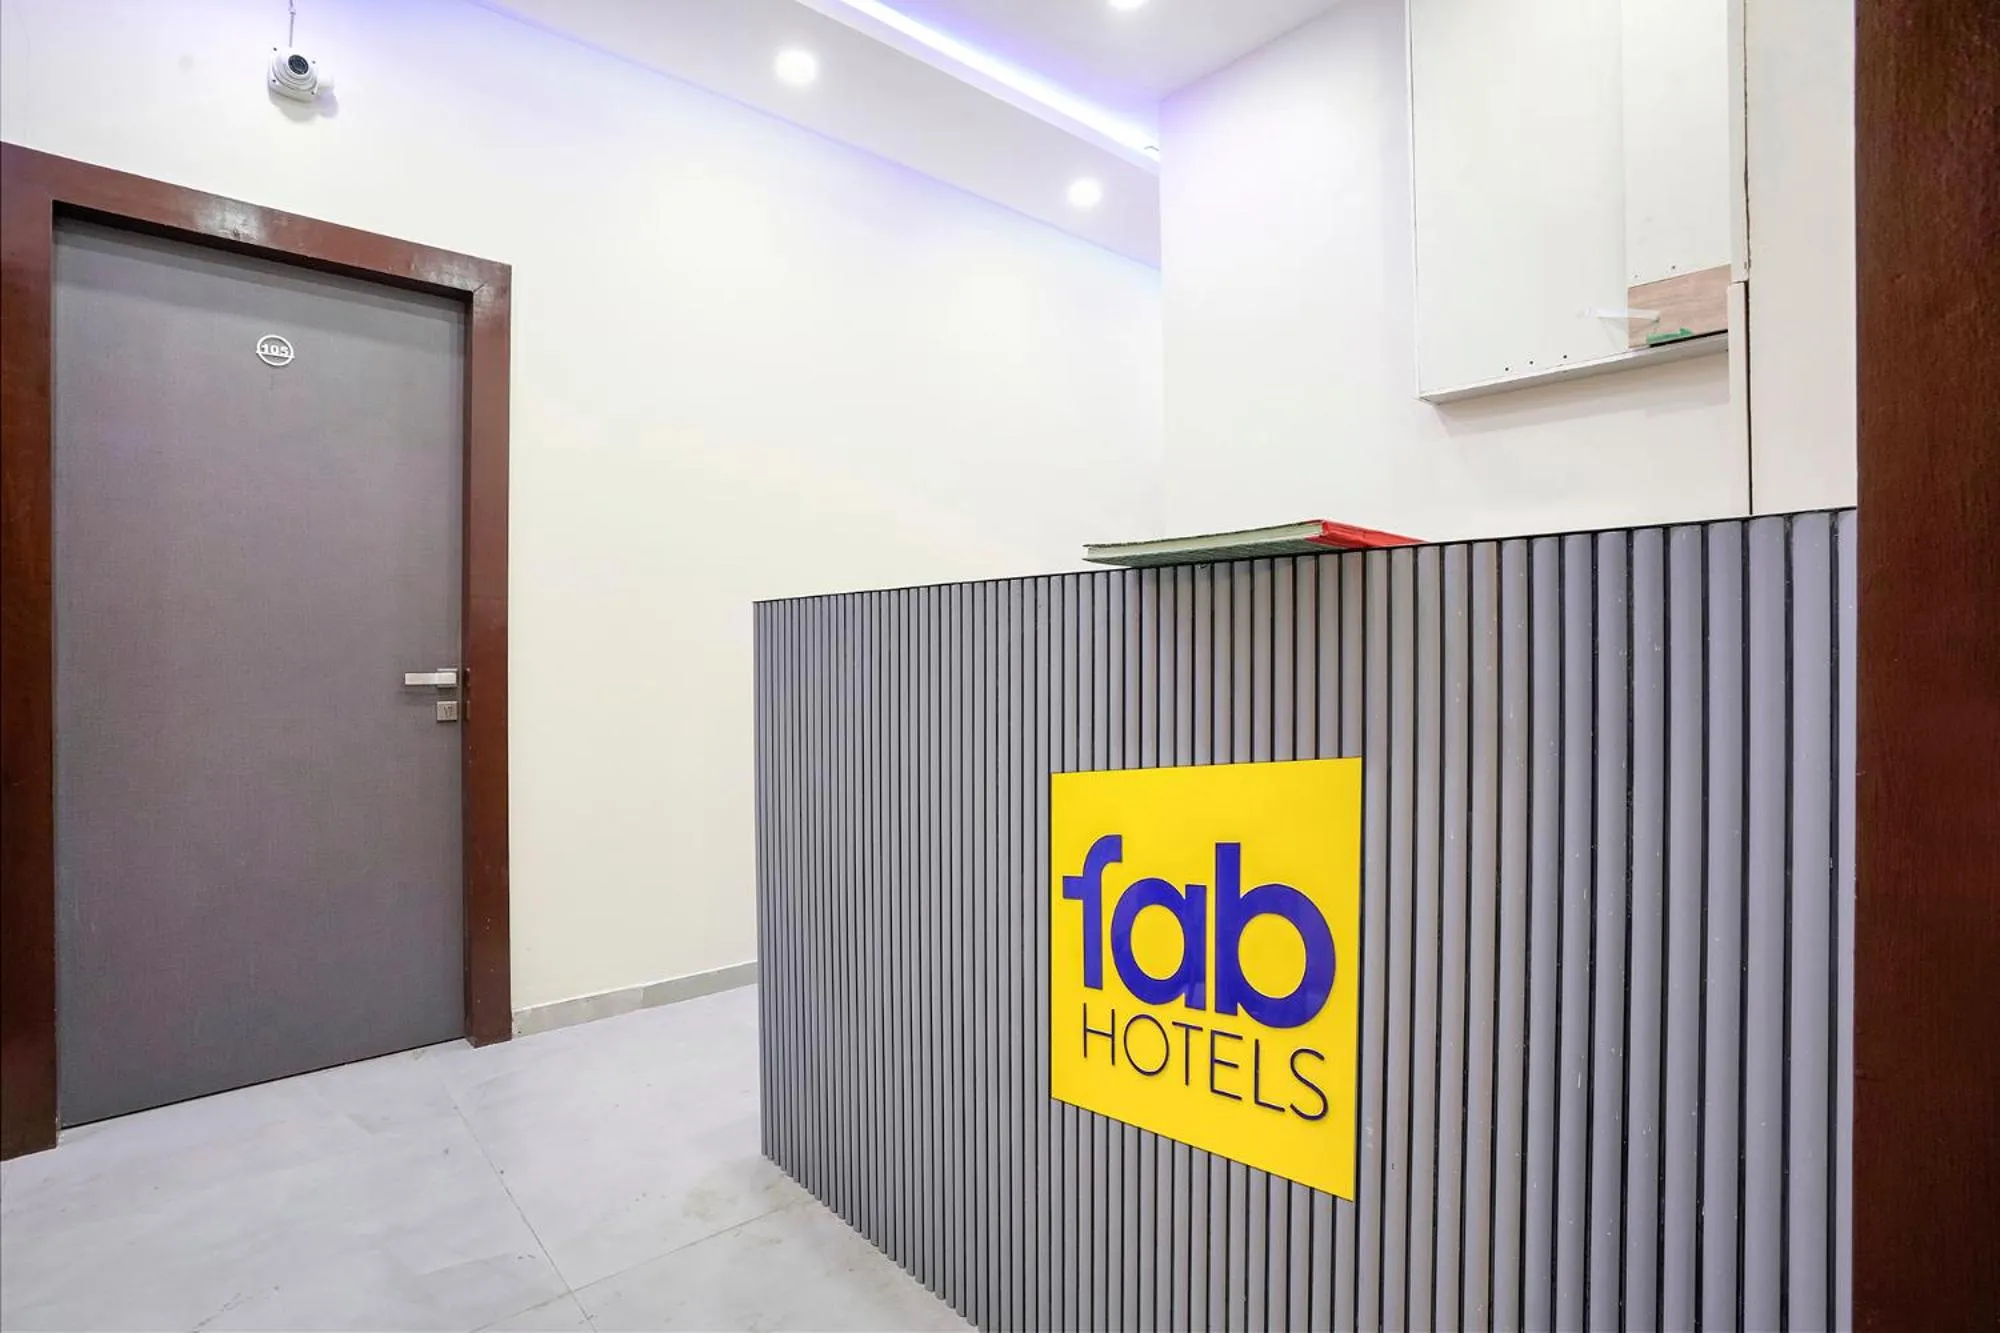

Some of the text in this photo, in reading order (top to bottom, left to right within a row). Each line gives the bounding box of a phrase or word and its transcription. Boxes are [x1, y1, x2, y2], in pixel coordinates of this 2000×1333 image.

[261, 343, 289, 357] 105
[1062, 834, 1336, 1029] fab
[1082, 1002, 1330, 1122] HOTELS
